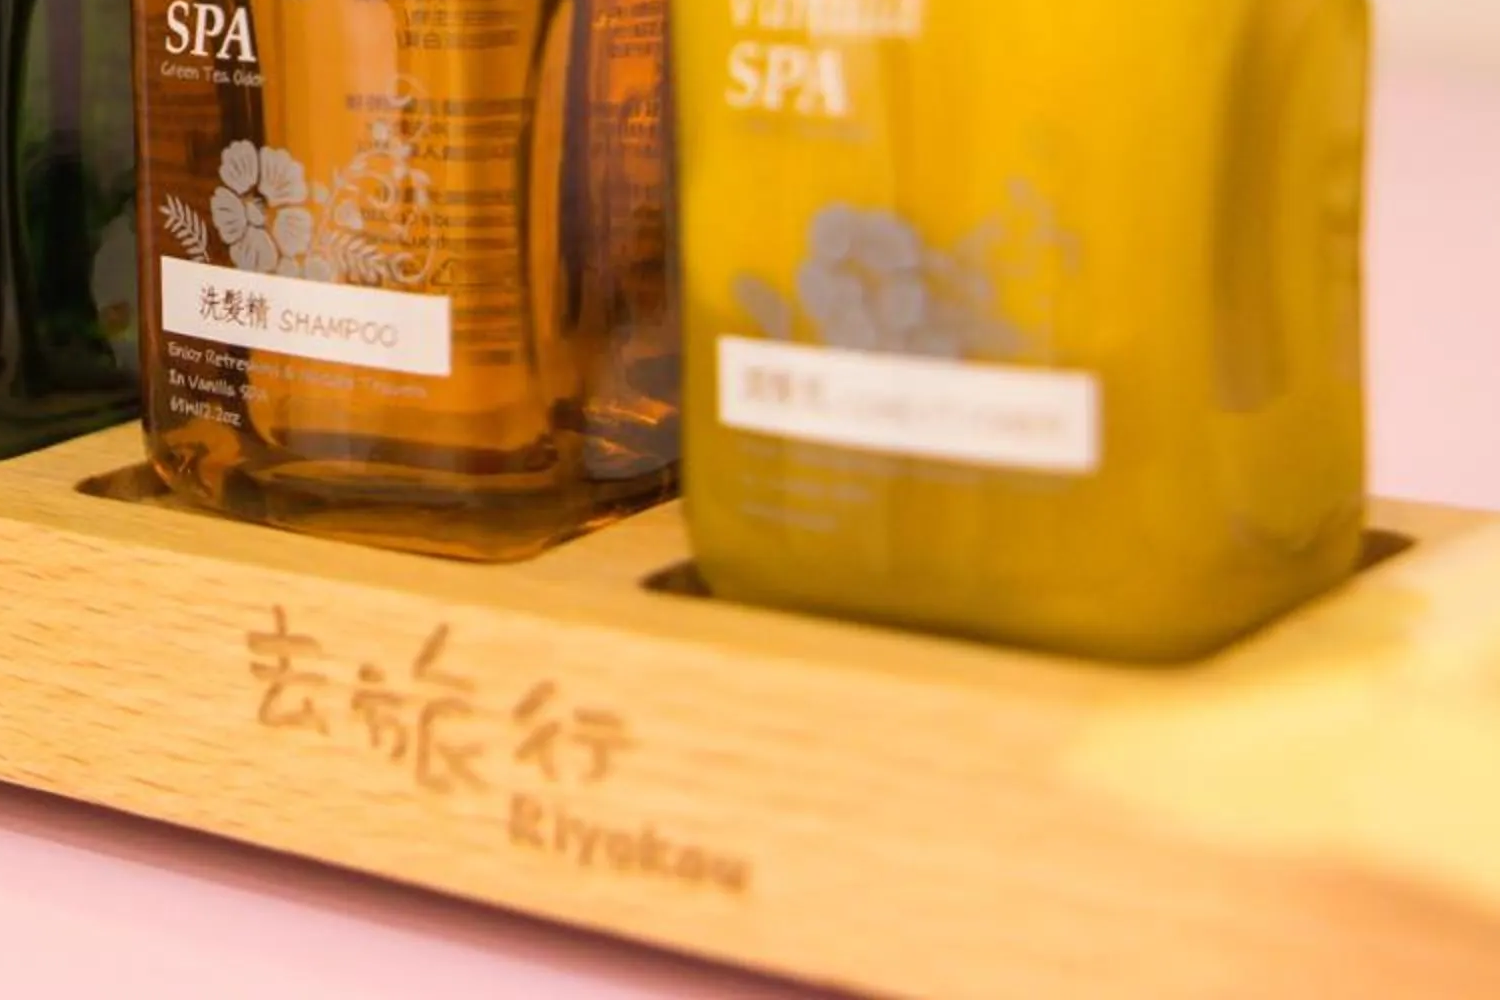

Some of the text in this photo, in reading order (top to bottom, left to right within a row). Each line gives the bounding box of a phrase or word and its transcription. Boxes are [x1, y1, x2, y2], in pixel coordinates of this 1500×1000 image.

[164, 0, 258, 63] SPA
[161, 60, 200, 81] Green
[202, 65, 230, 83] Tea
[724, 38, 852, 118] SPA
[199, 285, 399, 348] 洗髮精 SHAMPOO
[248, 604, 636, 792] 去旅行
